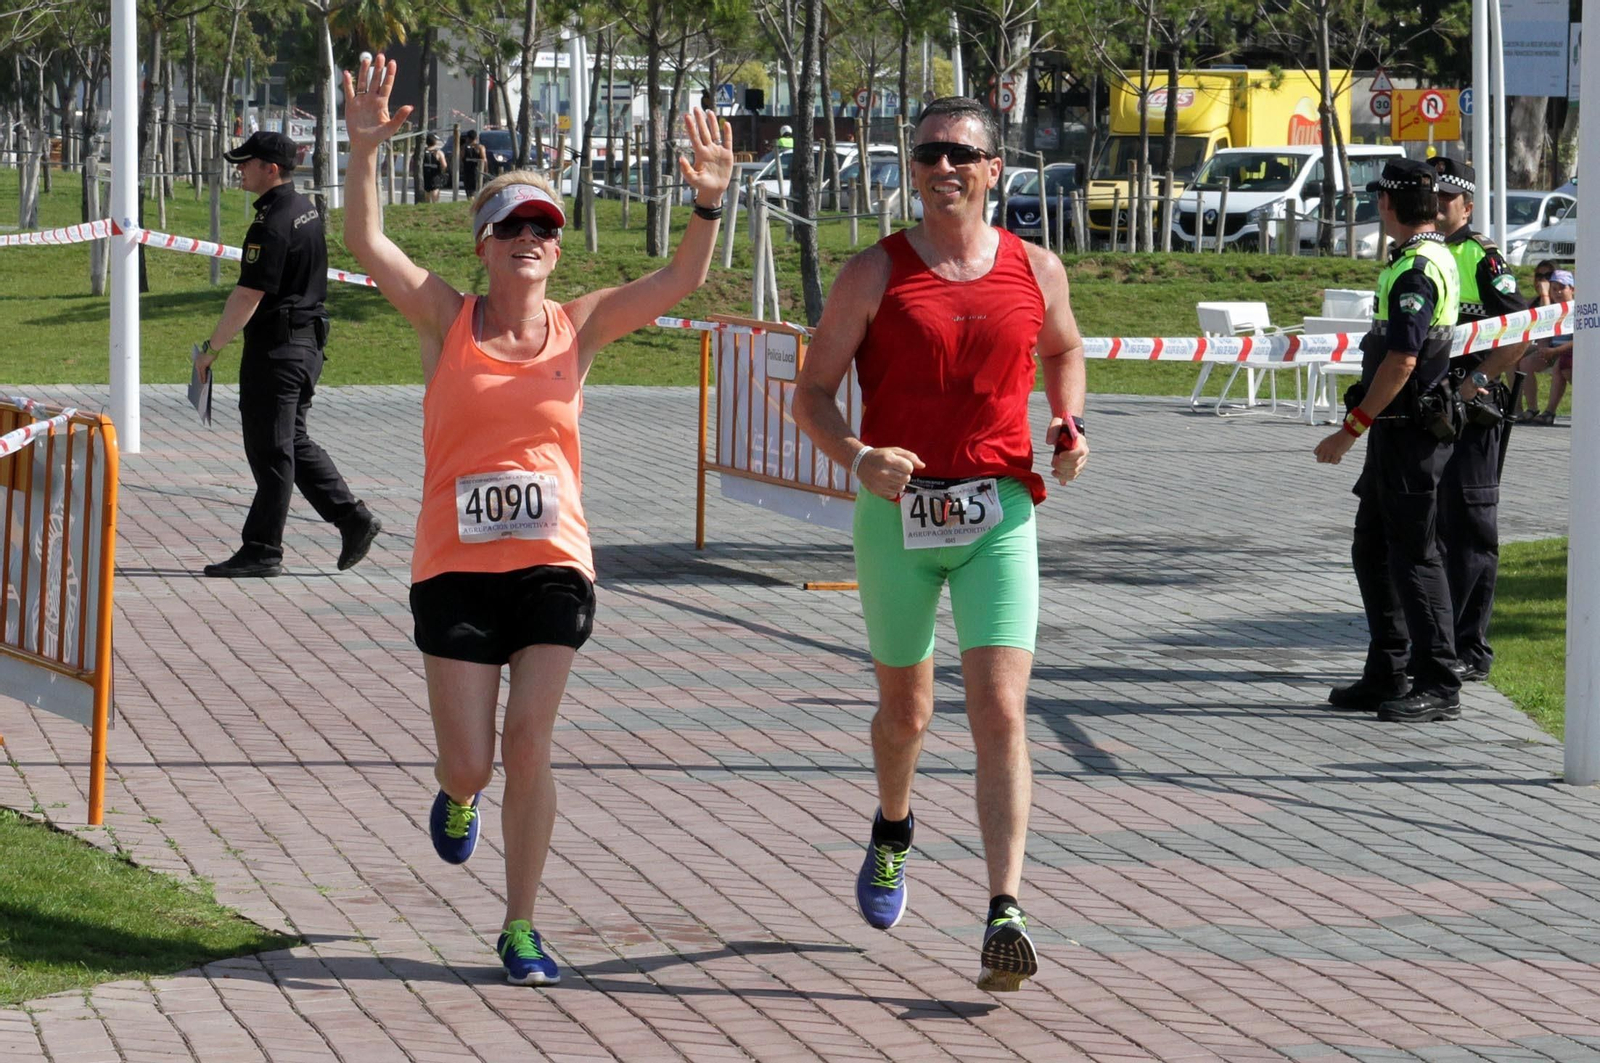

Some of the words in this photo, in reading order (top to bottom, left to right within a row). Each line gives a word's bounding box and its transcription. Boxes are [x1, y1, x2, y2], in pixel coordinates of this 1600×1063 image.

[1376, 100, 1390, 110] 30
[1576, 303, 1598, 315] PASAR
[782, 350, 796, 364] Local
[465, 482, 543, 524] 4090
[909, 494, 986, 528] 4045
[509, 521, 549, 531] DEPORTIVA
[953, 525, 991, 535] DEPORTIVA
